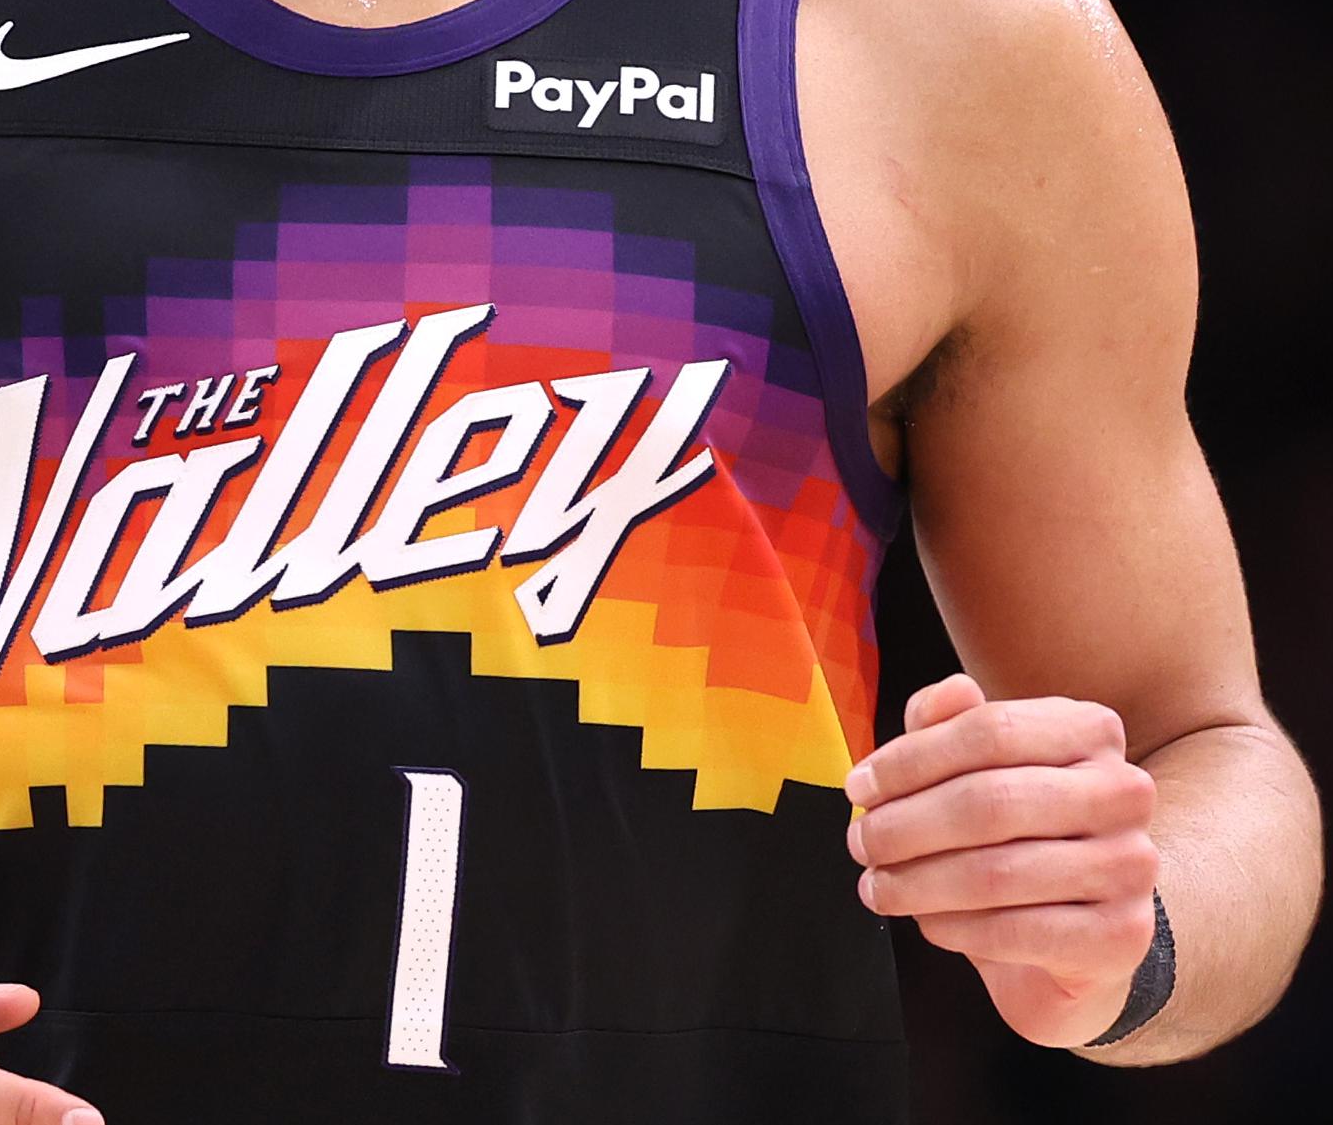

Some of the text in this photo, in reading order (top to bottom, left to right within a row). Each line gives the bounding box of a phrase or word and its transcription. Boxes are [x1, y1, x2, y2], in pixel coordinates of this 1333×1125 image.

[494, 59, 716, 128] PayPal
[131, 364, 279, 446] THE
[384, 767, 467, 1074] 1
